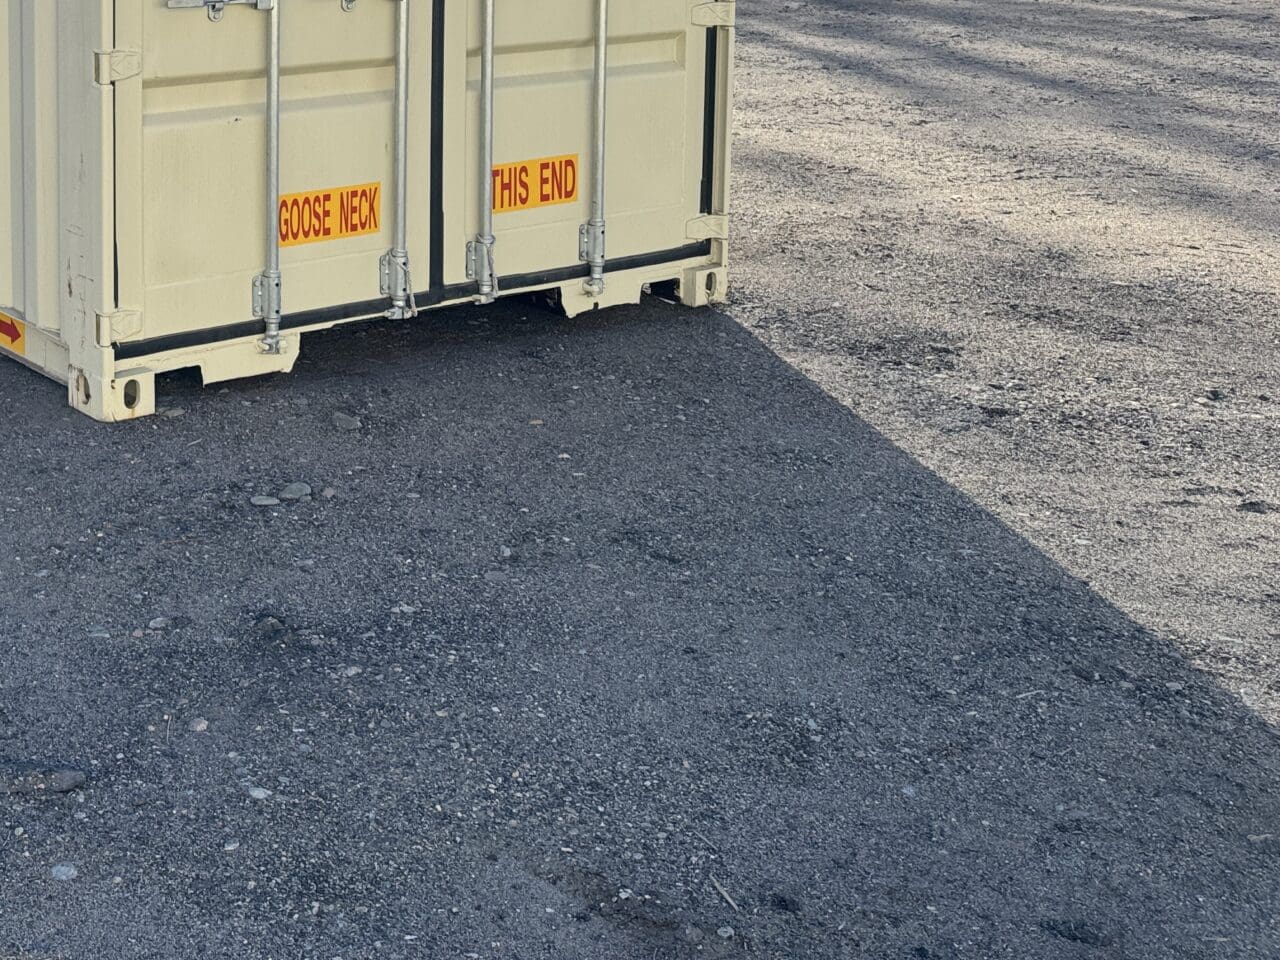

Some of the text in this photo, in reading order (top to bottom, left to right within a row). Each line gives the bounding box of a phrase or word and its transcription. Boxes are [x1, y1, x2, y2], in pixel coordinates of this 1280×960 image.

[492, 159, 576, 210] THIS END
[278, 187, 378, 242] GOOSE NECK
